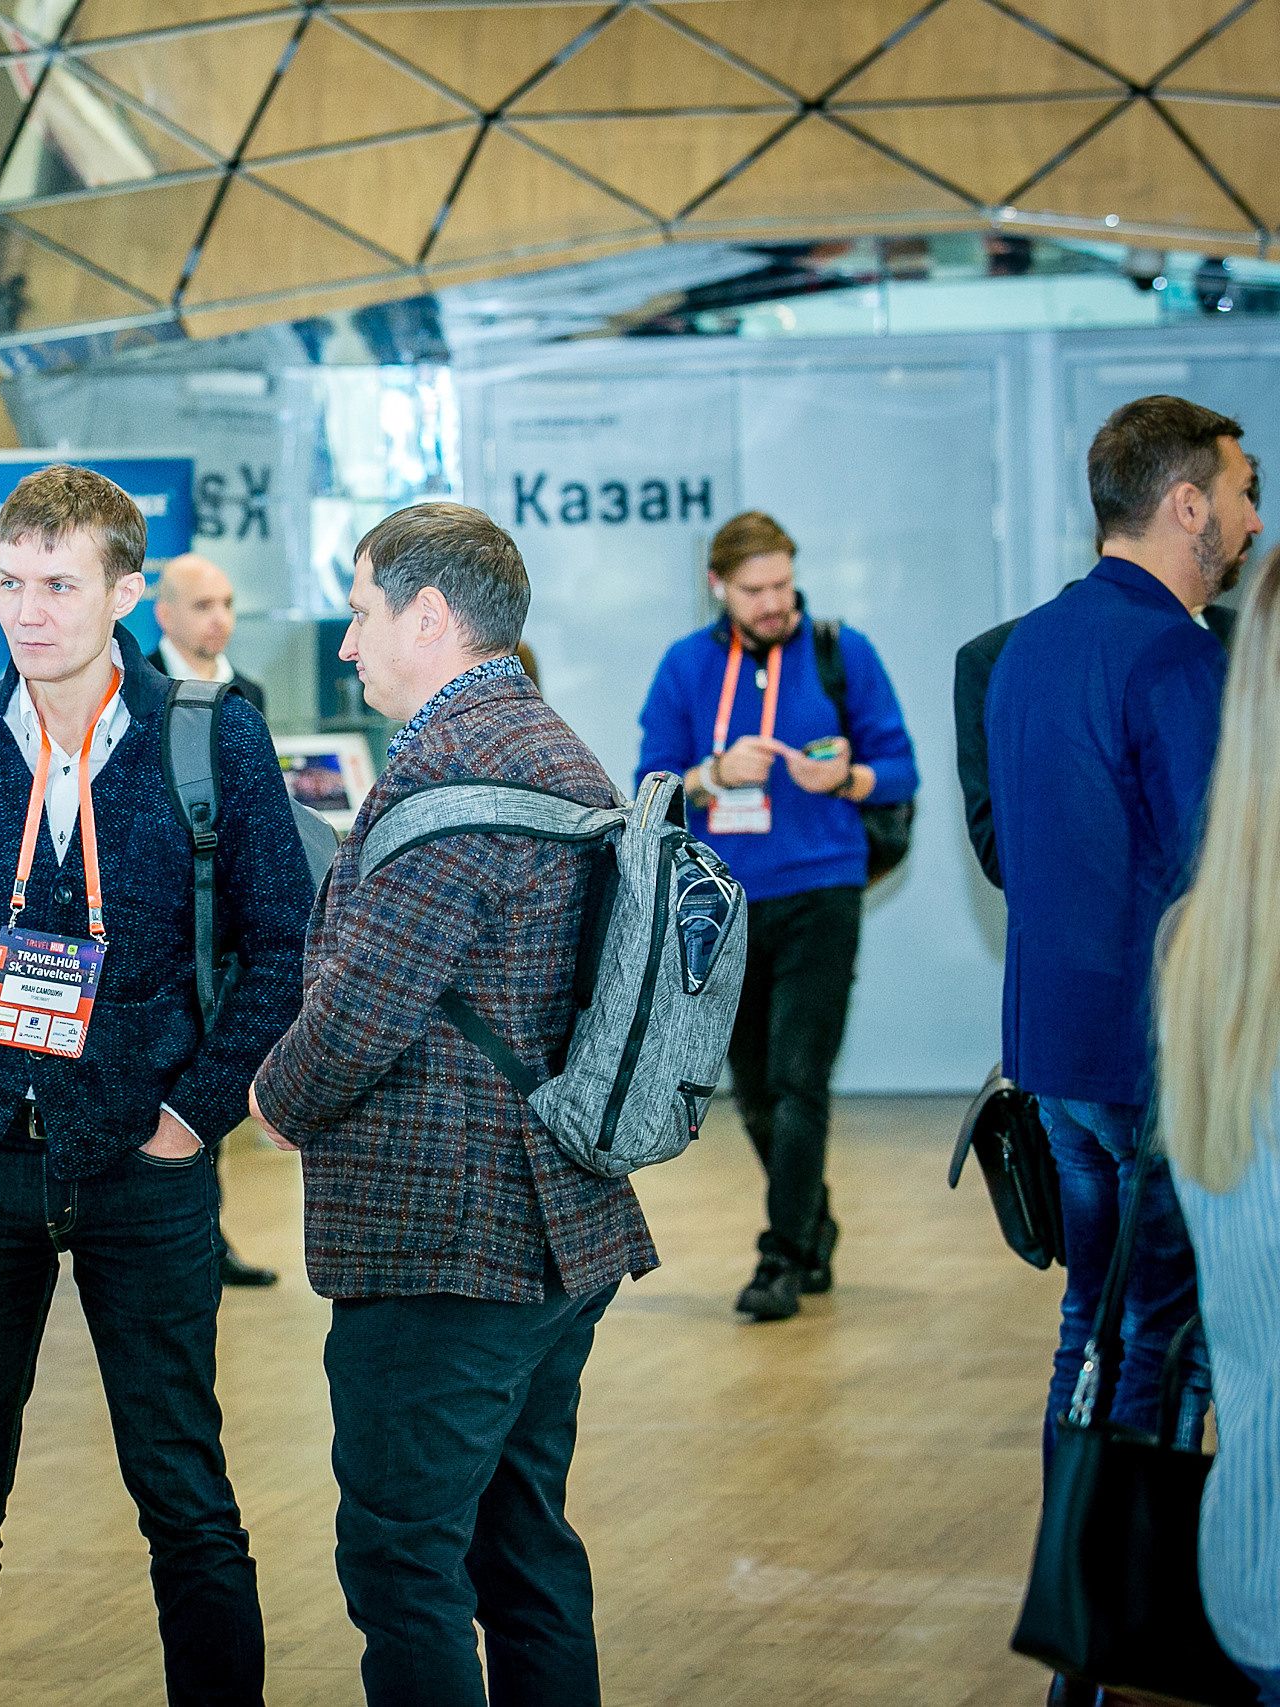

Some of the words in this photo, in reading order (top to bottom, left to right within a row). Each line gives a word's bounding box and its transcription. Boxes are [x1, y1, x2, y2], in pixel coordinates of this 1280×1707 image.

[513, 473, 712, 526] Казан
[17, 950, 81, 970] TRAVELHUB
[8, 961, 83, 983] Sk_Traveltech
